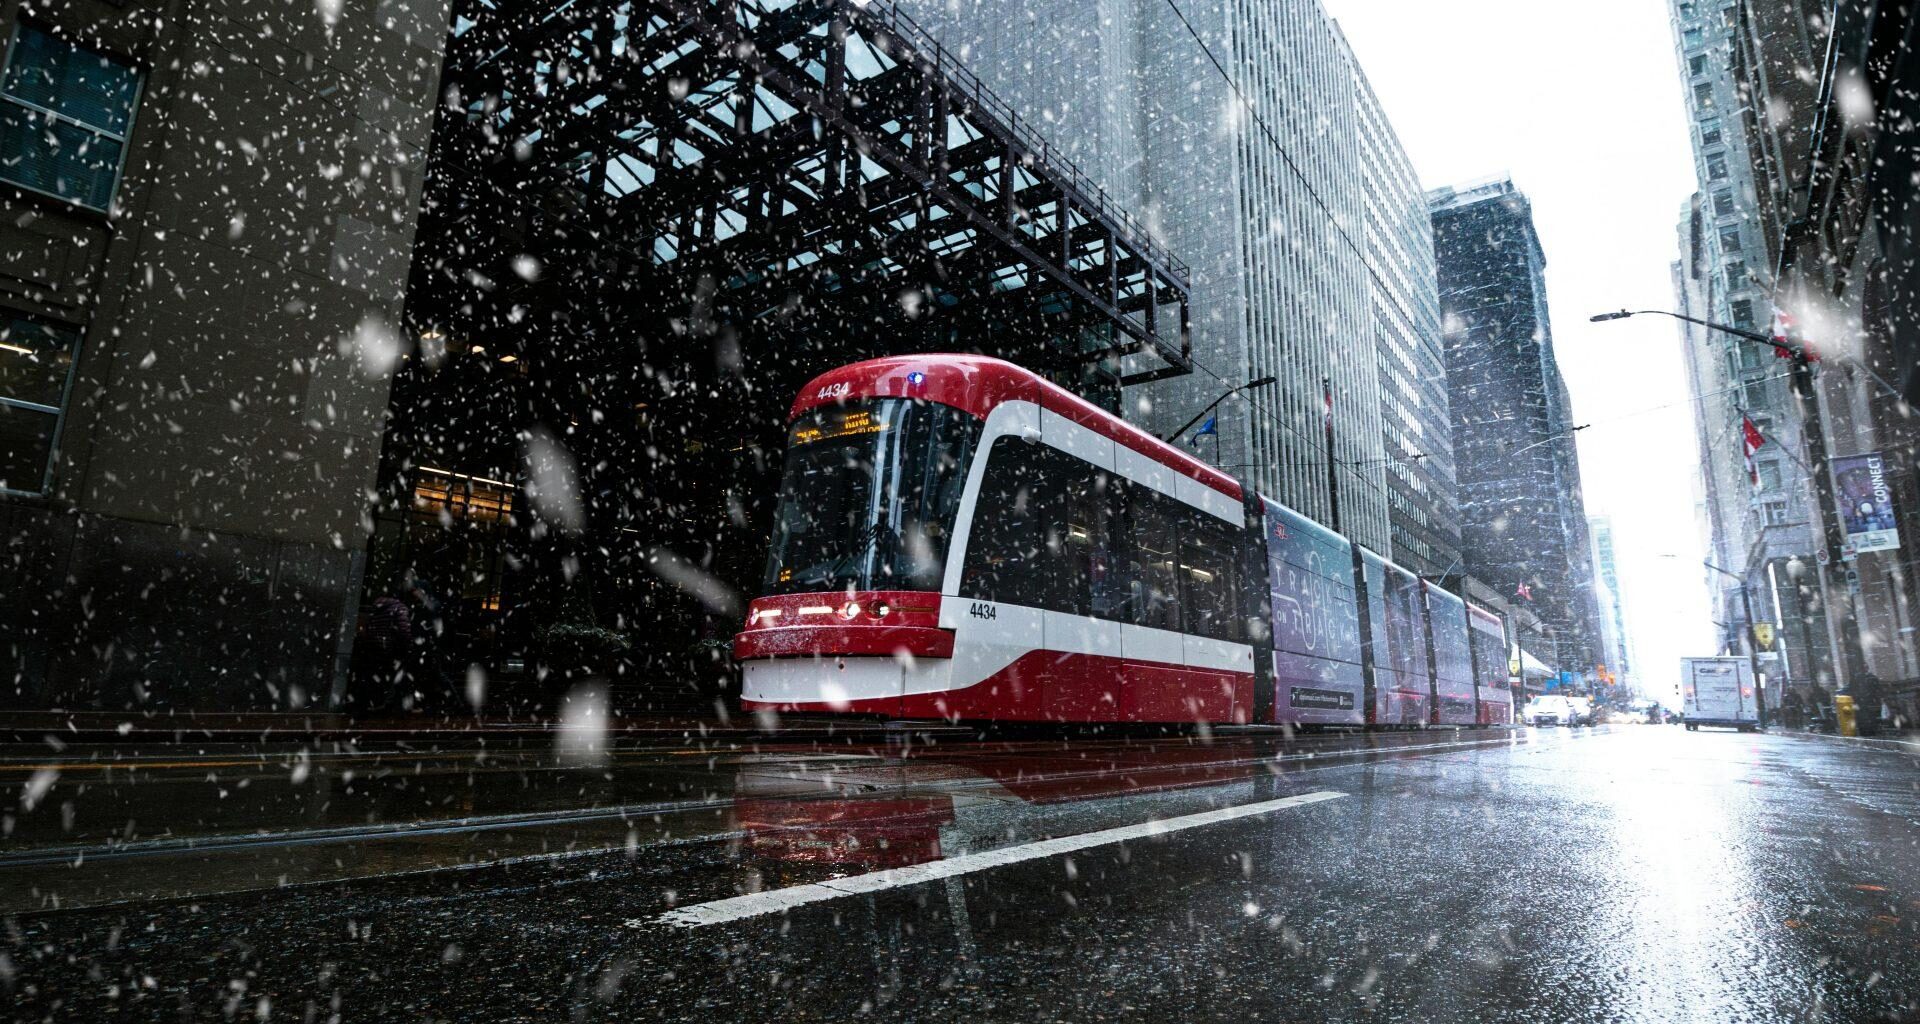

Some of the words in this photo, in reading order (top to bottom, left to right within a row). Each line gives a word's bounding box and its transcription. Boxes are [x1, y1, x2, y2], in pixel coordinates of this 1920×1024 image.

[817, 382, 849, 399] 4434
[1867, 456, 1887, 503] CONNECT
[970, 602, 996, 620] 4434
